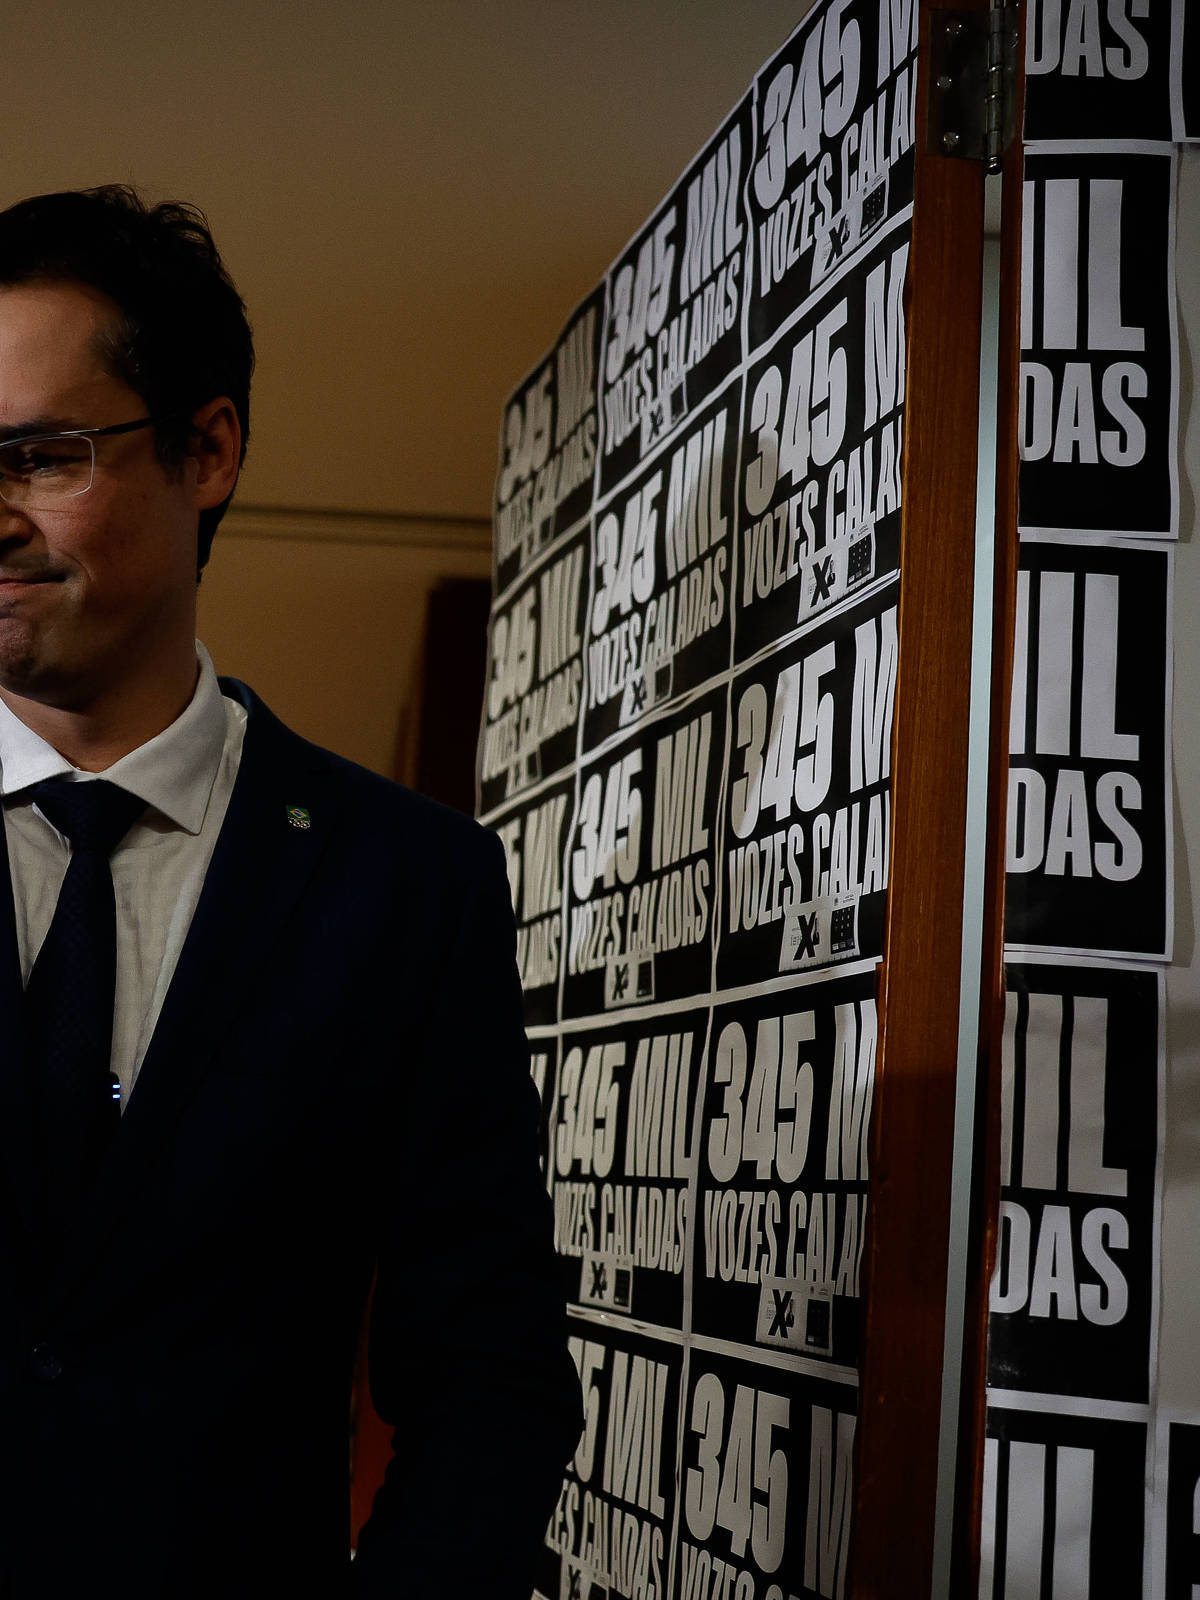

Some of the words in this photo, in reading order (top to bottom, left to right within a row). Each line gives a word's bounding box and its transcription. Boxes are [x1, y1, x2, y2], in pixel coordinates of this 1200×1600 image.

[753, 0, 862, 209] 345
[759, 152, 833, 298] VOZES
[745, 297, 848, 516] 345
[591, 469, 663, 637] 345
[666, 407, 729, 580] MIL
[743, 479, 819, 608] VOZES
[643, 546, 728, 668] CALADAS
[572, 748, 643, 900] 345
[651, 711, 713, 872] MIL
[730, 641, 836, 839] 345
[627, 858, 710, 958] CALADAS
[729, 824, 804, 934] VOZES
[555, 1040, 627, 1179] 345
[624, 1031, 695, 1180] MIL
[707, 1009, 816, 1184] 345
[599, 1182, 689, 1275] CALADAS
[704, 1188, 781, 1285] VOZES
[603, 1350, 669, 1520] MIL
[685, 1372, 791, 1574] 345
